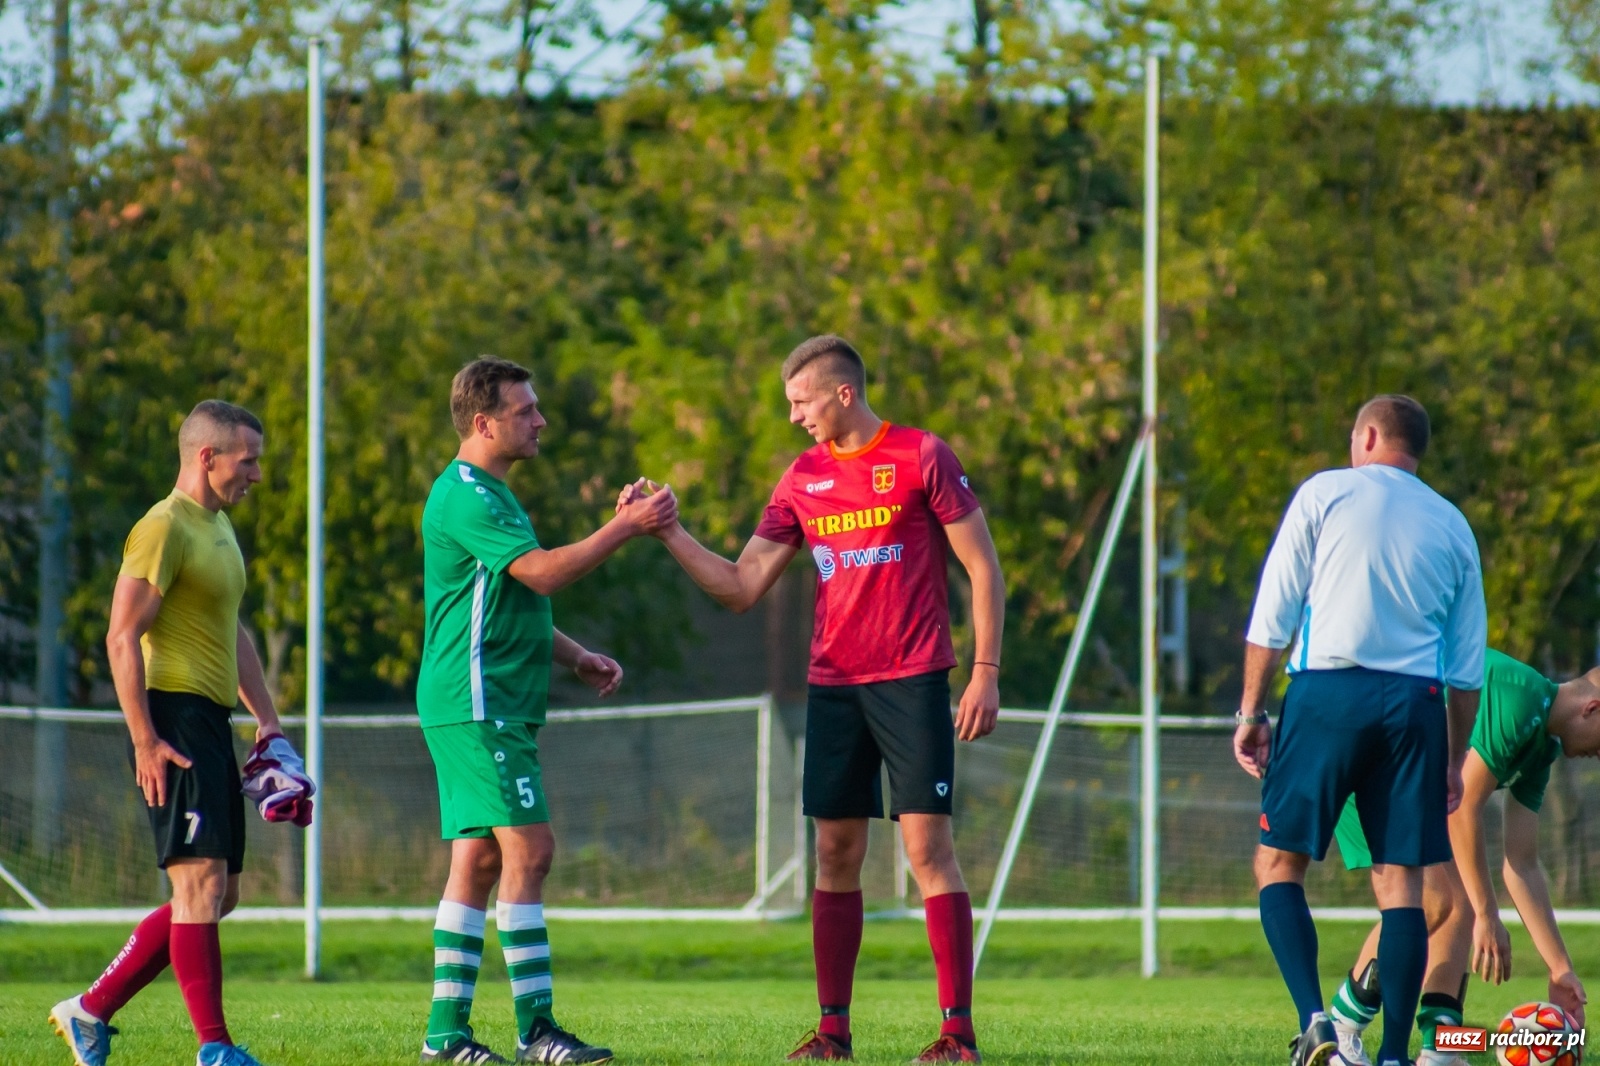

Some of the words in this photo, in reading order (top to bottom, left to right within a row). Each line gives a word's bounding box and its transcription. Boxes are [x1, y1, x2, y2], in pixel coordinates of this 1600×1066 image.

[840, 544, 904, 569] TWIST
[515, 776, 535, 809] 5
[184, 811, 201, 844] 7
